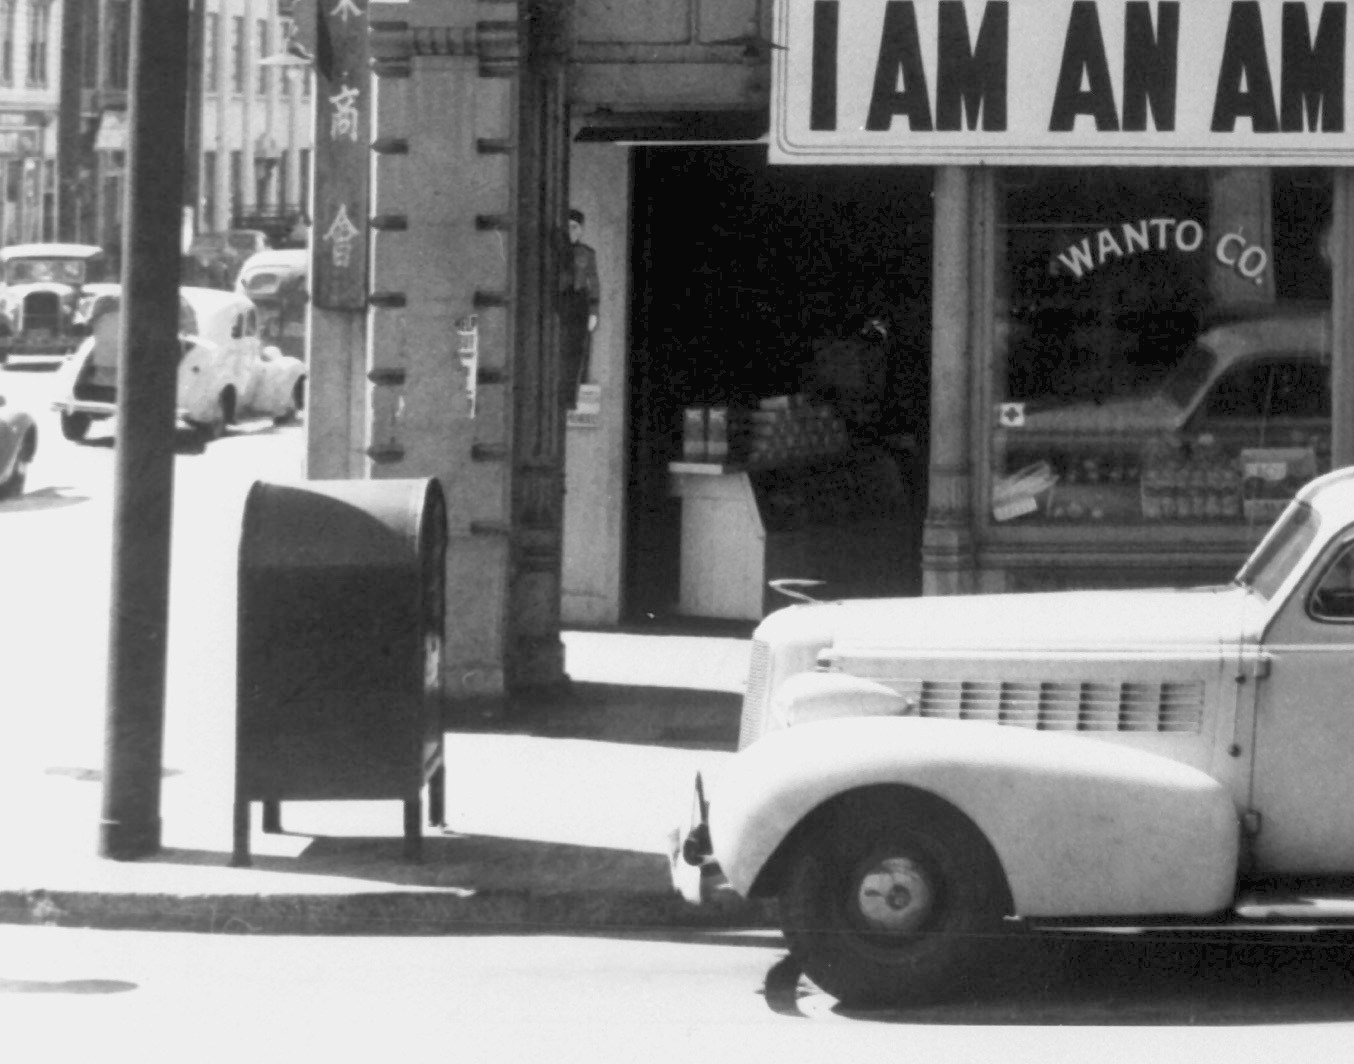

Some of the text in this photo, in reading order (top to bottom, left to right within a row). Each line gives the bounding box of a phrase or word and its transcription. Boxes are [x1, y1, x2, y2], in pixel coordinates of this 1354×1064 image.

[811, 0, 840, 133] I
[866, 0, 1010, 133] AM
[1049, 0, 1181, 134] AN
[1057, 217, 1205, 279] WANTO
